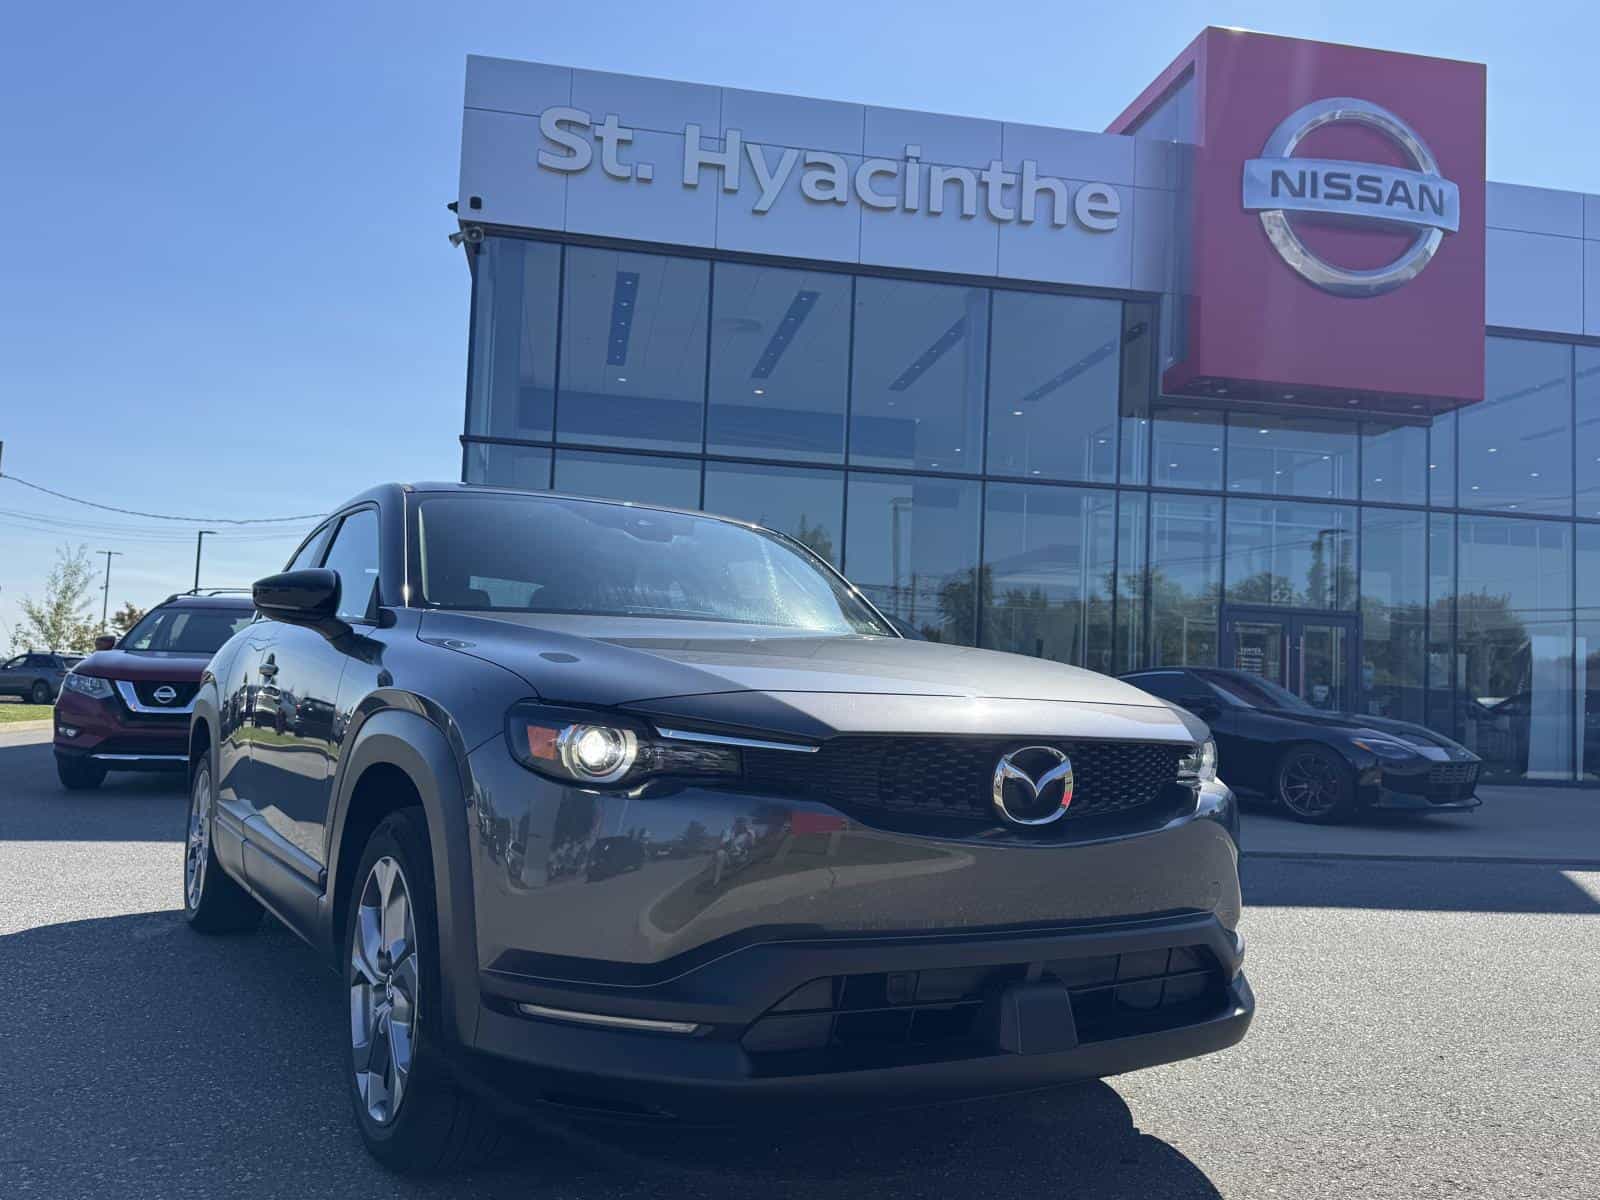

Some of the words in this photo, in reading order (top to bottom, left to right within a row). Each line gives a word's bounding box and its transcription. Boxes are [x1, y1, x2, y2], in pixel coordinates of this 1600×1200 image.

[538, 106, 654, 182] St.
[682, 122, 1121, 232] Hyacinthe
[1271, 169, 1444, 217] NISSAN
